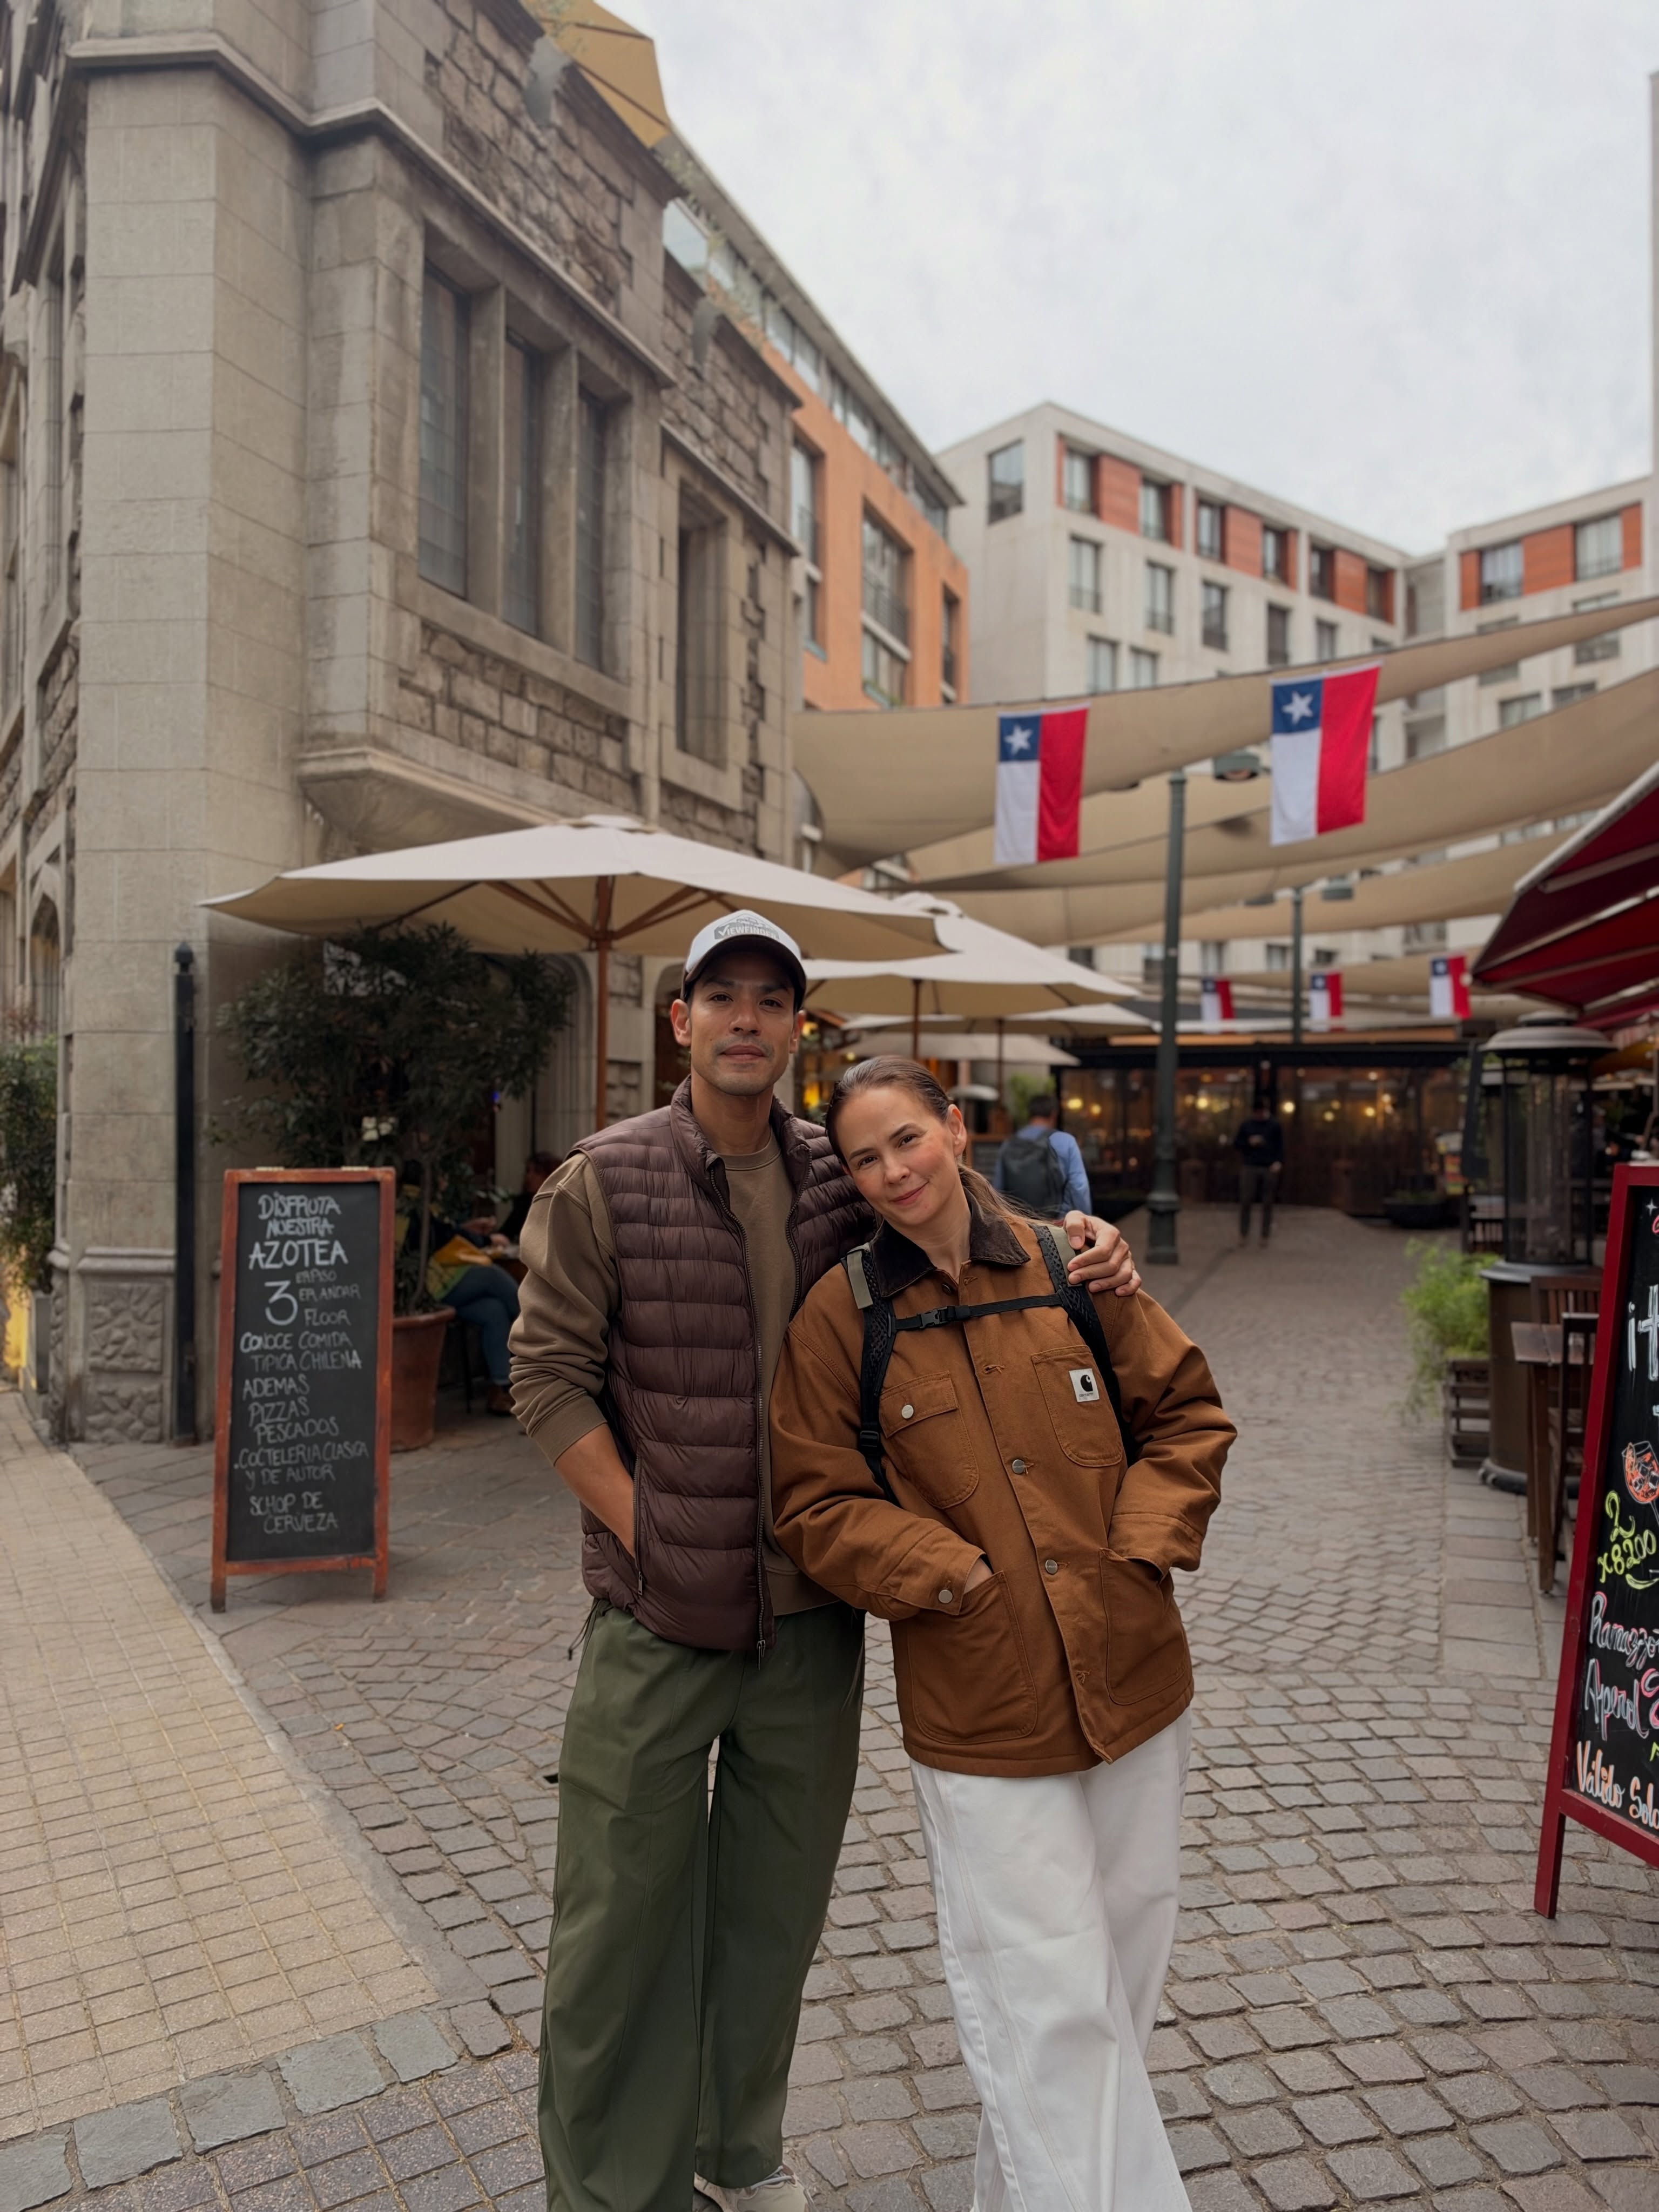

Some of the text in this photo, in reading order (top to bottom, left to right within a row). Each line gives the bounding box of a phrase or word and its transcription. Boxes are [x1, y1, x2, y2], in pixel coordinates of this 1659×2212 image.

[266, 1217, 335, 1240] NUESTRA
[248, 1238, 349, 1270] AZOTEA
[264, 1280, 299, 1326] 3
[304, 1308, 352, 1327] FLOOR
[240, 1330, 354, 1353] CONOCE COMIDA
[299, 1350, 362, 1372] CHILENA
[242, 1373, 311, 1401] ADEMAS
[247, 1396, 311, 1427] PIZZAS
[253, 1415, 340, 1446] PESCADOS
[261, 1468, 282, 1486] DE
[286, 1464, 336, 1482] AUTOR
[249, 1491, 323, 1516] SCHOP DE
[1605, 1491, 1636, 1542] 2
[263, 1512, 339, 1534] CERVEZA
[1589, 1591, 1659, 1670] Ramazzo
[1584, 1658, 1649, 1742] Aperol
